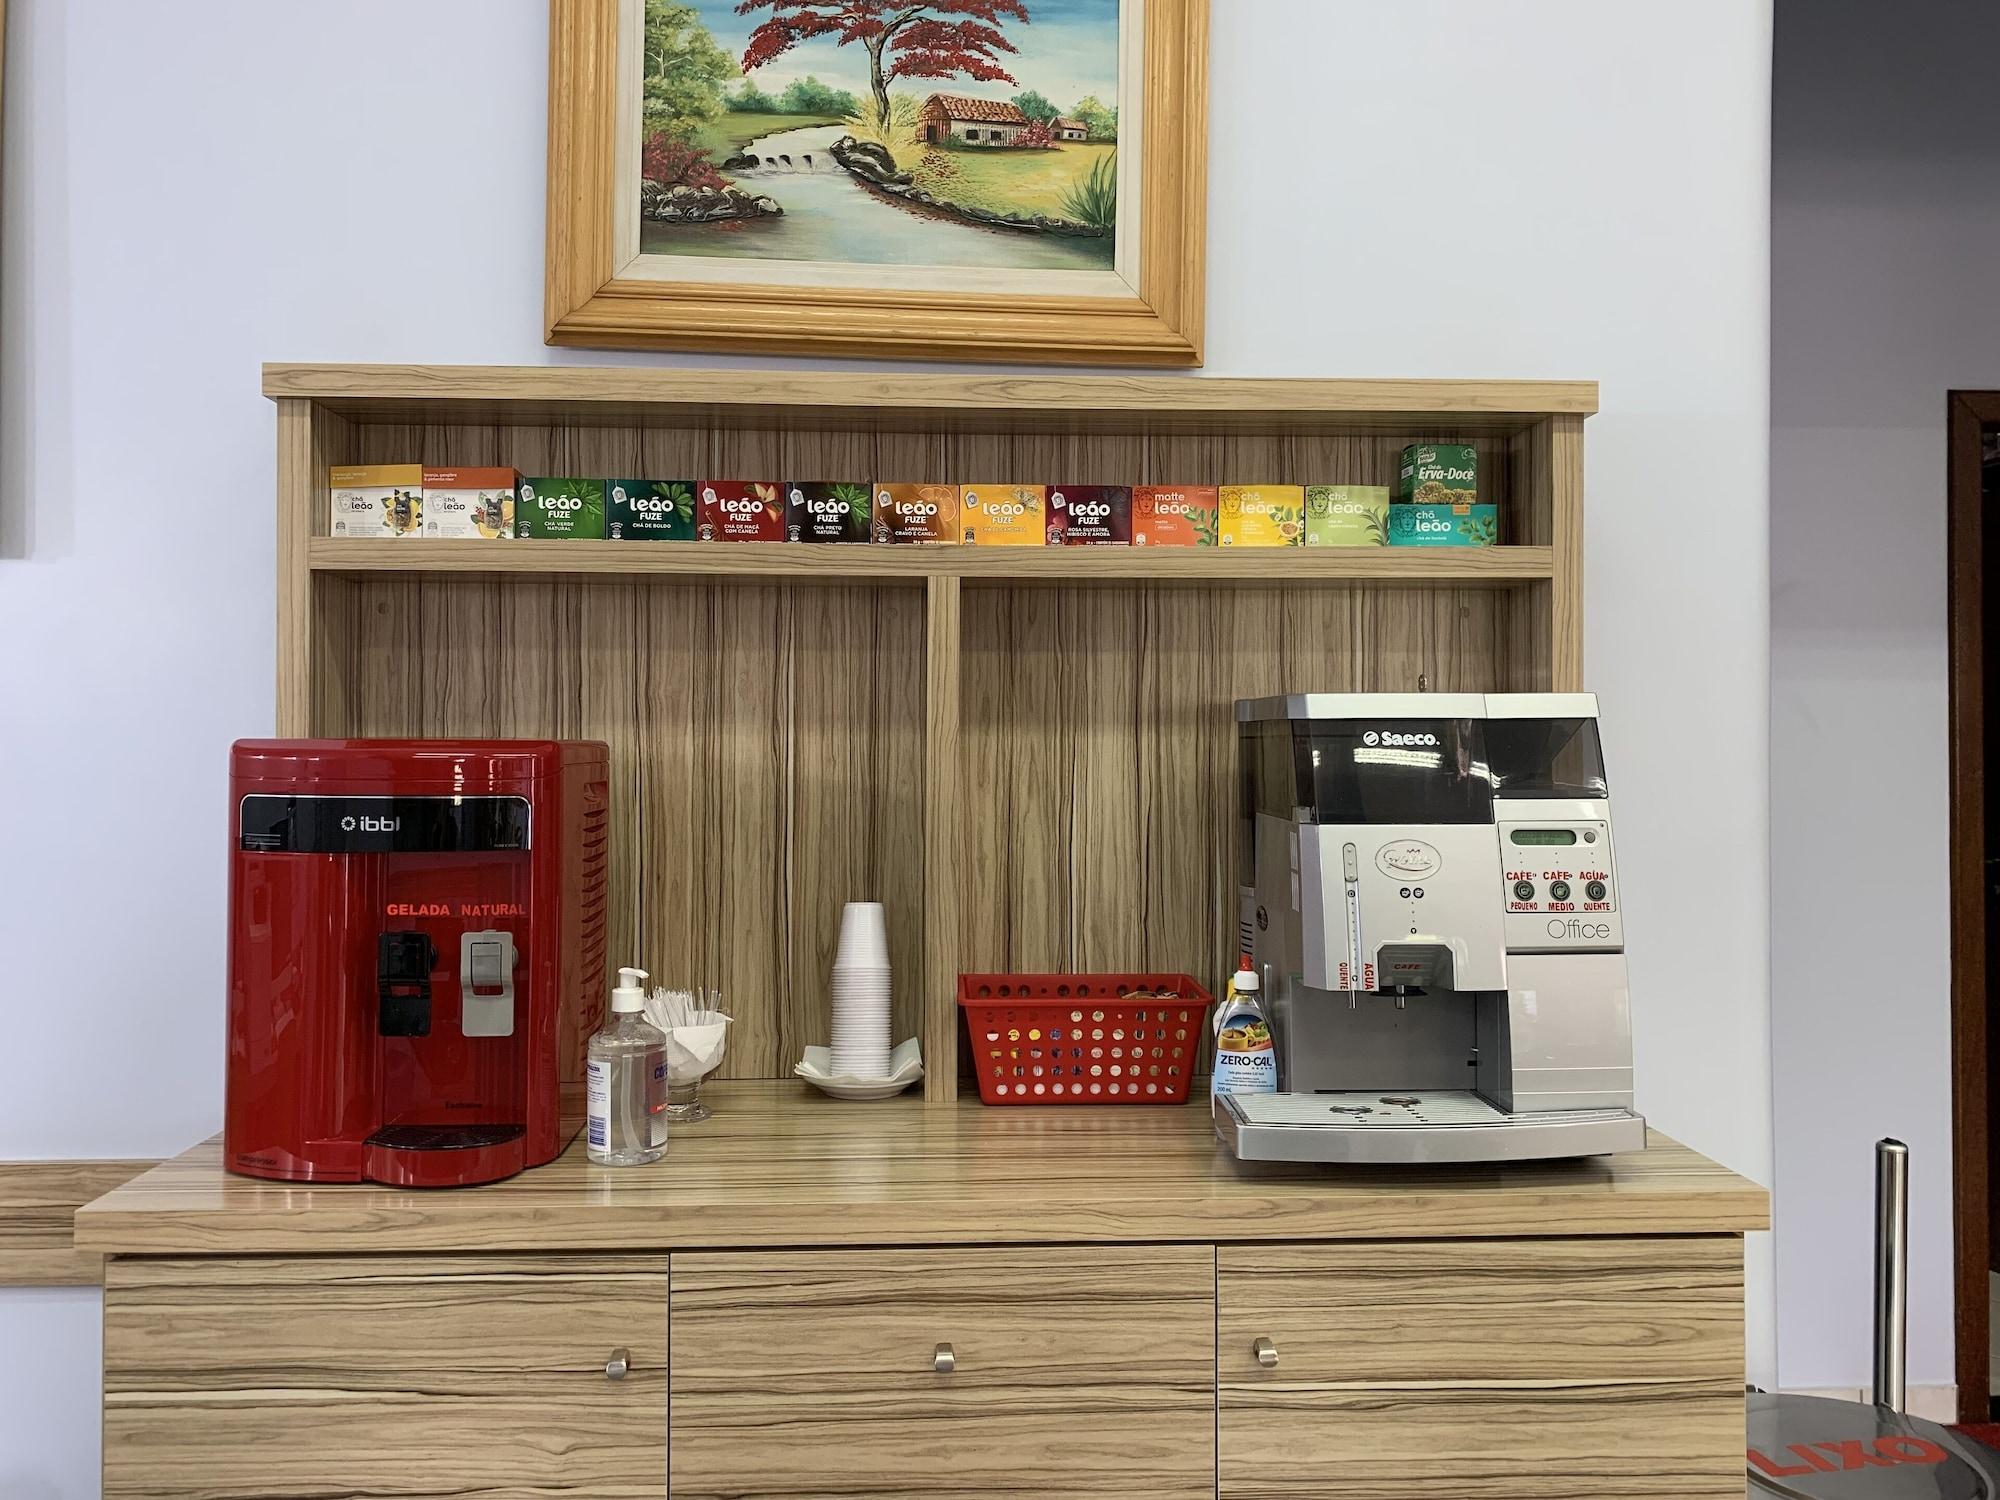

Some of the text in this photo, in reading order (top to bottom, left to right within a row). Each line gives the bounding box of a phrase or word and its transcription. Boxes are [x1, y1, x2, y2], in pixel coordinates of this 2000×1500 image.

[1418, 467, 1474, 480] Erva-Doce
[1155, 492, 1185, 501] matte
[1241, 492, 1260, 500] chá
[1328, 492, 1348, 500] chá
[351, 501, 373, 510] leão
[443, 502, 466, 511] leão
[538, 495, 582, 510] leão
[629, 496, 674, 512] leão
[720, 497, 763, 513] leão
[807, 499, 850, 513] leão
[895, 500, 938, 515] leão
[982, 501, 1025, 515] leão
[1069, 501, 1111, 516] leão
[1155, 501, 1190, 514] leão
[1241, 501, 1275, 514] leão
[1328, 501, 1364, 514] leão
[640, 512, 663, 520] FUZE
[730, 513, 752, 521] FUZE
[817, 514, 839, 522] FUZE
[905, 516, 926, 524] FUZE
[1415, 510, 1435, 519] chá
[1078, 517, 1100, 525] FUZE
[1415, 519, 1451, 532] leão
[360, 816, 400, 833] ibbl
[1506, 871, 1532, 880] CAFE
[1543, 871, 1569, 880] CAFE
[1579, 871, 1606, 880] AGUA
[386, 903, 526, 917] GELADA NATURAL
[1511, 902, 1538, 910] PEQUENO
[1548, 902, 1575, 911] MEDIO
[1583, 902, 1611, 911] QUENTE
[1547, 919, 1610, 938] Office
[1339, 962, 1349, 990] QUENTE
[1364, 963, 1374, 990] AGUA
[1220, 1055, 1272, 1067] ZERO-CAL
[1747, 1436, 1949, 1477] LIXO
